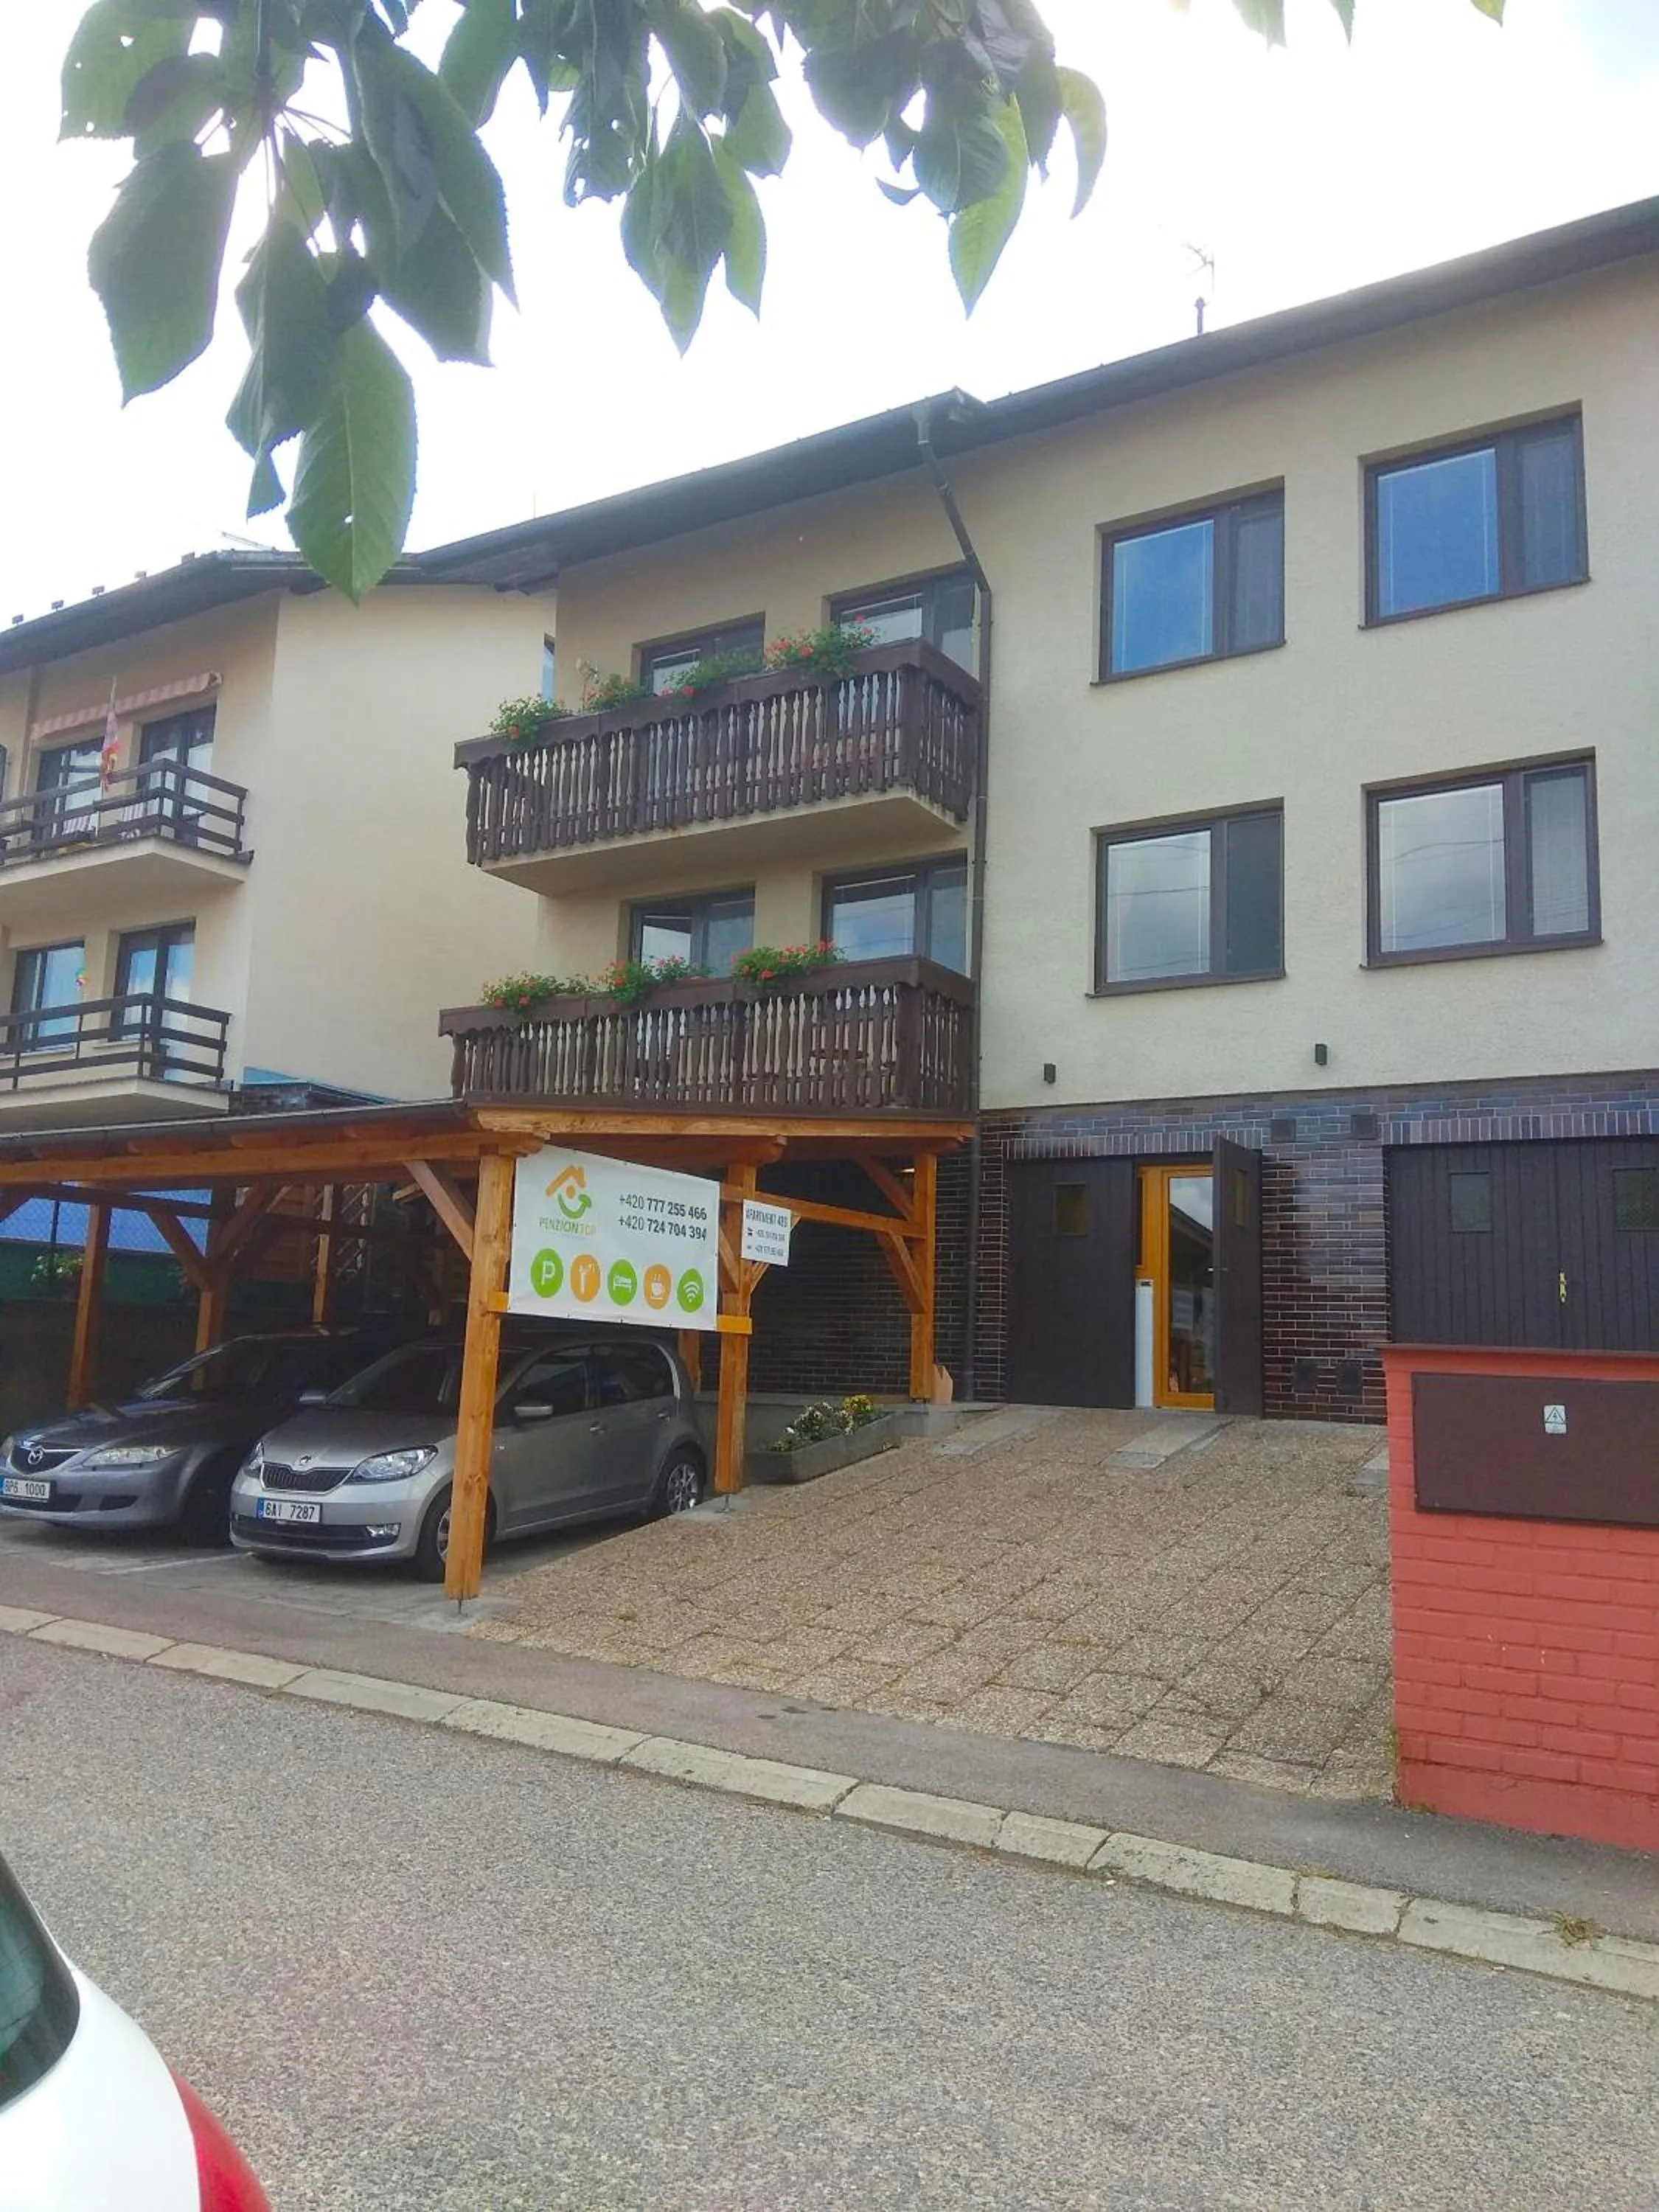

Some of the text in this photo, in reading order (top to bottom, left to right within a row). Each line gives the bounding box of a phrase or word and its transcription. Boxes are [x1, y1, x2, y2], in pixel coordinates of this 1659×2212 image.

[619, 1194, 707, 1220] +420 777 255 466
[618, 1214, 707, 1242] +420 724 704 394
[25, 1483, 46, 1496] 1000
[291, 1505, 315, 1520] 7287
